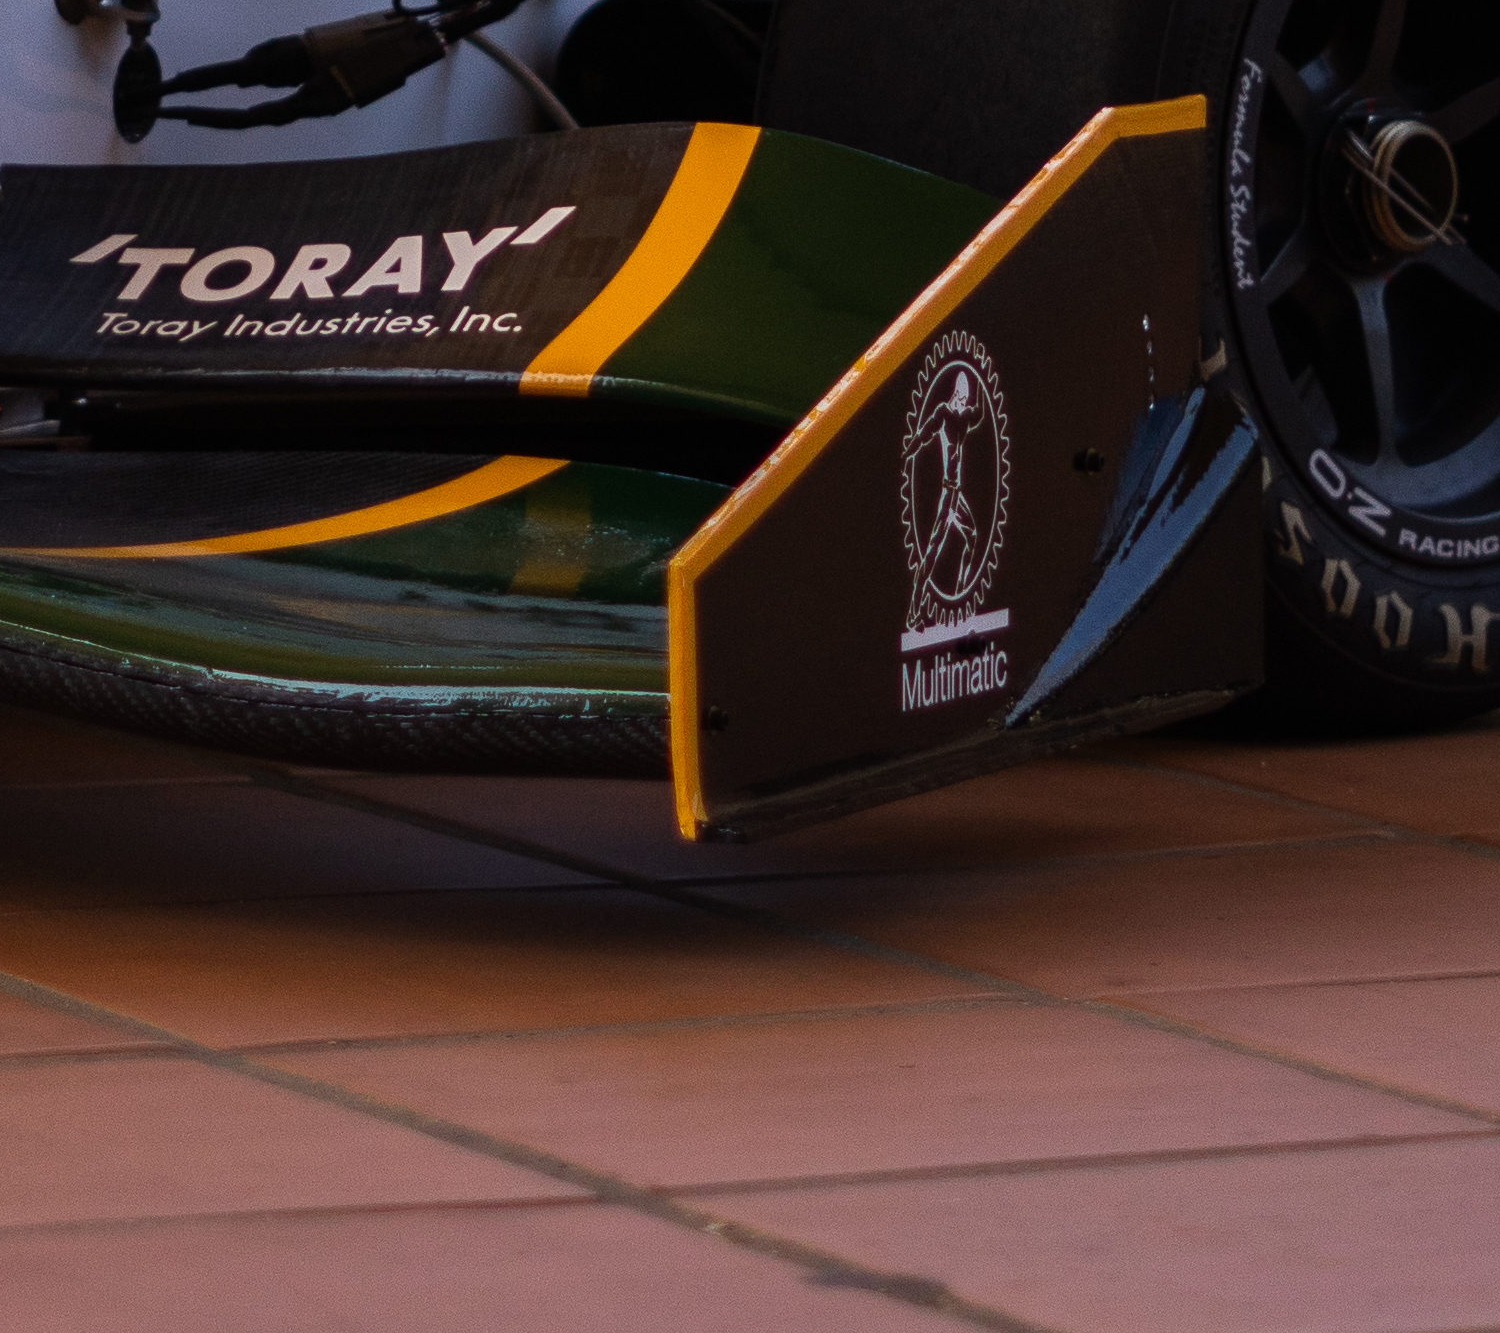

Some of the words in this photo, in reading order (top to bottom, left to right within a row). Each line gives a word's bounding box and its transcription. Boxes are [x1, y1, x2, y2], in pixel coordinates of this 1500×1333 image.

[97, 312, 218, 342] Toray
[223, 308, 440, 338] Industries,
[450, 306, 523, 333] Inc.
[901, 641, 1008, 712] Multimatic
